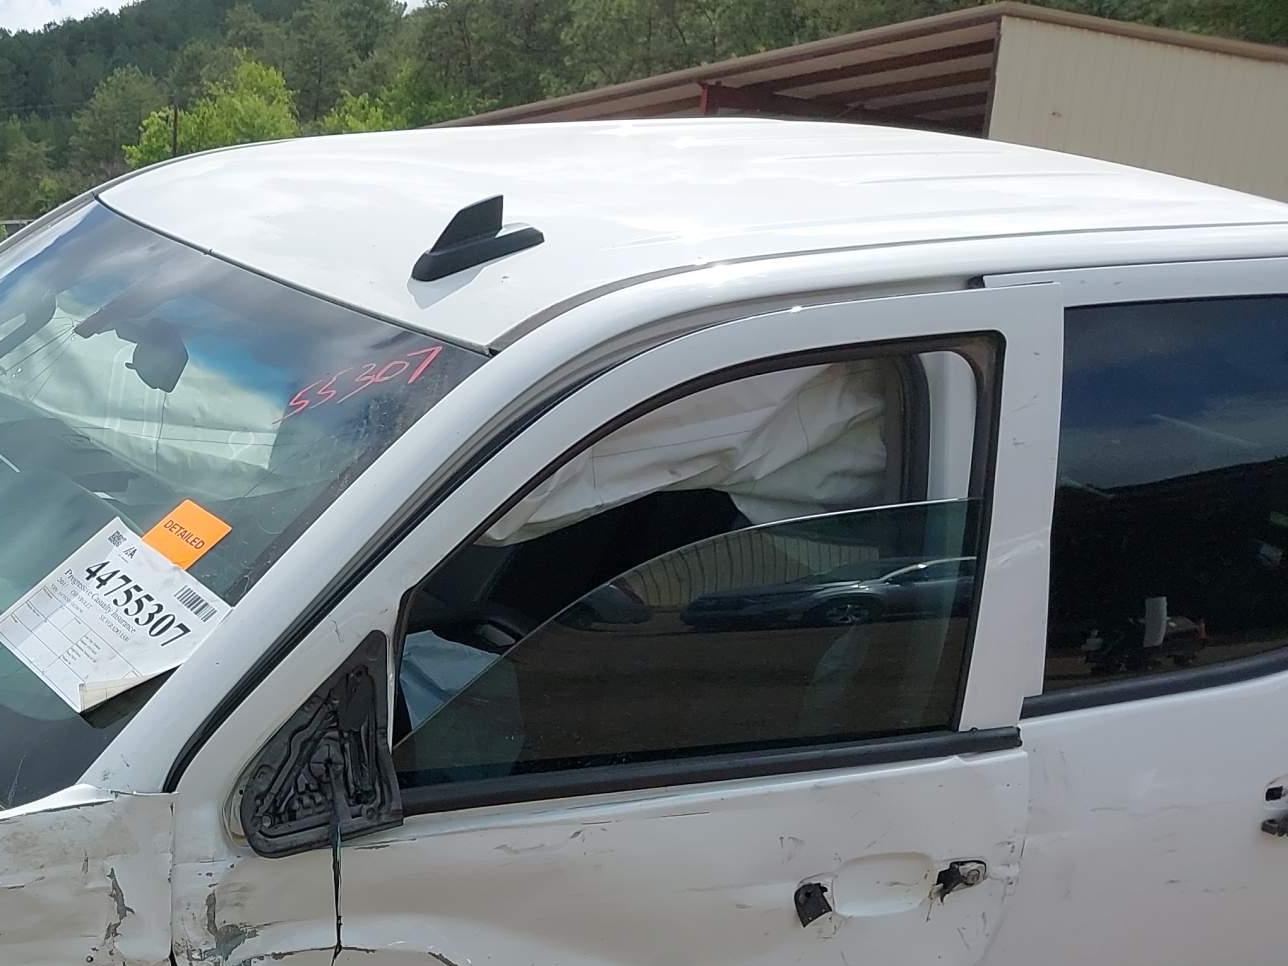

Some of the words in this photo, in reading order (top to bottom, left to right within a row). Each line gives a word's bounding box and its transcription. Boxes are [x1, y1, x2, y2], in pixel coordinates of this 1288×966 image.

[271, 345, 444, 425] 55307
[163, 519, 206, 551] DETAILED
[64, 568, 93, 596] Progressive
[91, 593, 112, 613] Casualty
[111, 610, 136, 633] Insurance
[85, 560, 192, 647] 44755307
